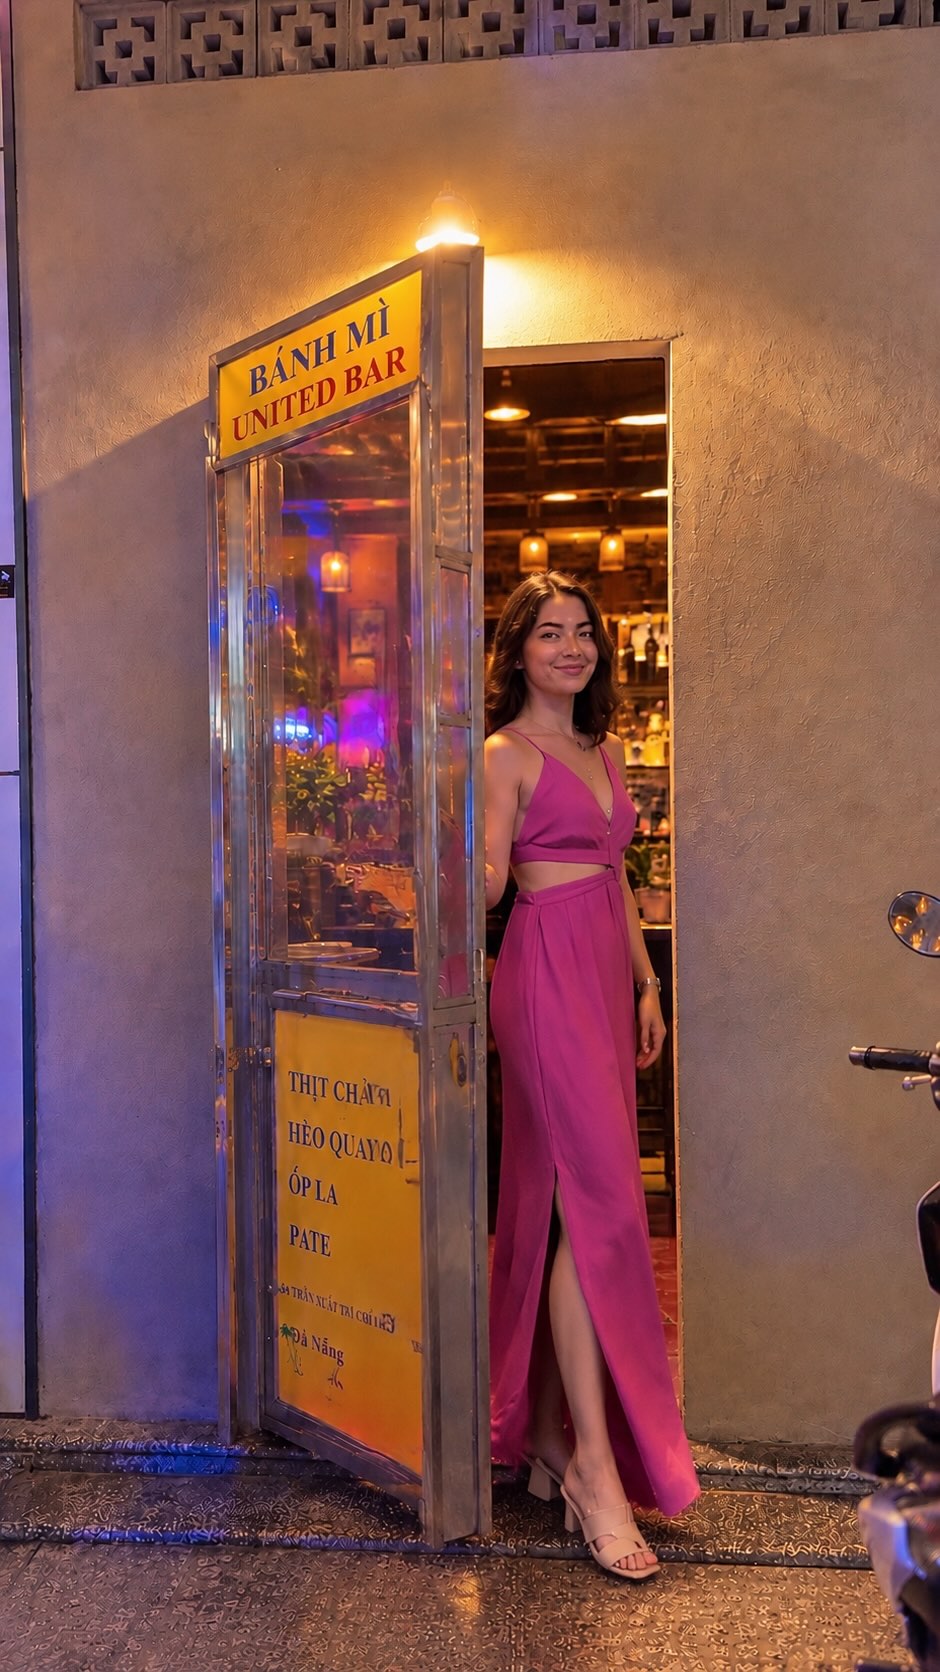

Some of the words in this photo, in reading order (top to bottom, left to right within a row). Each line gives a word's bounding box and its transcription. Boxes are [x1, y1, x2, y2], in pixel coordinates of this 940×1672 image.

[249, 330, 337, 397] BÁNH
[346, 297, 390, 355] MÌ
[232, 376, 336, 441] UNITED
[343, 346, 407, 396] BAR
[288, 1071, 329, 1103] THỊT
[288, 1119, 325, 1150] HÈO
[315, 1179, 338, 1206] LA
[289, 1223, 332, 1258] PATE
